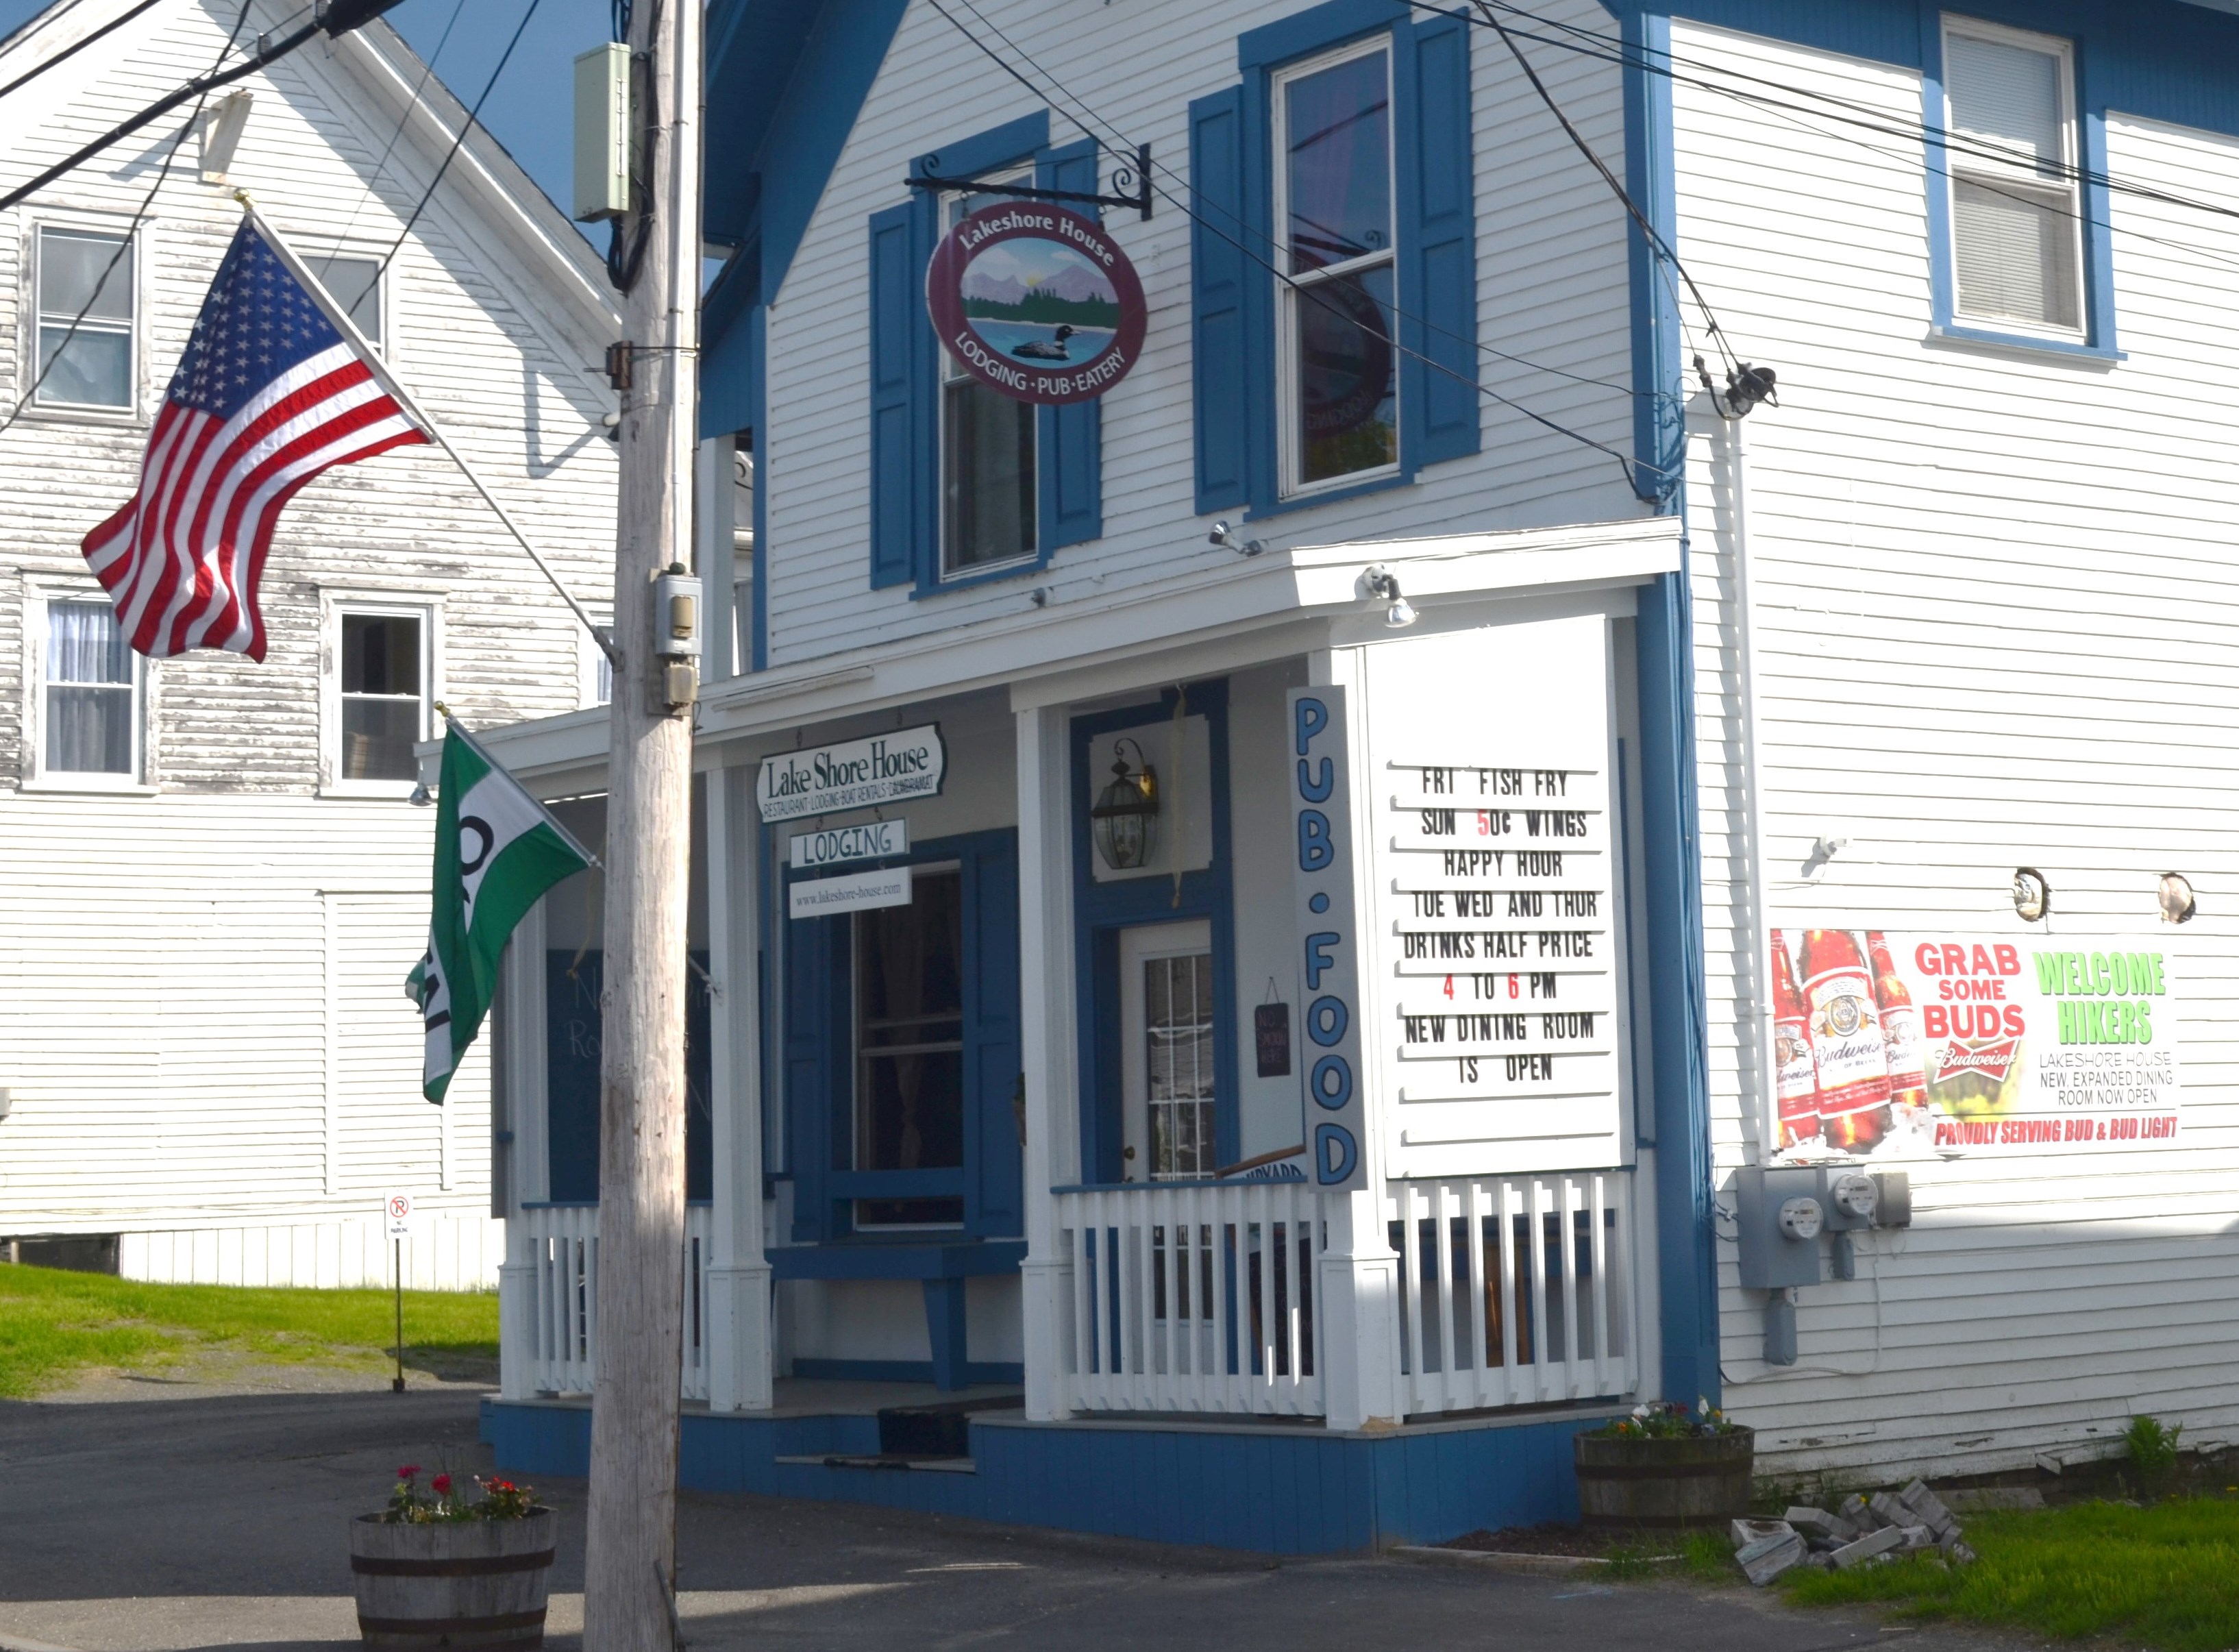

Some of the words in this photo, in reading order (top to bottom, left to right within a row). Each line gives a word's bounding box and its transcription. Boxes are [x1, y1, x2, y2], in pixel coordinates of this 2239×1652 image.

[958, 211, 1054, 251] Lakeshore
[1059, 217, 1114, 266] House
[955, 332, 1028, 391] LODGING
[1037, 378, 1071, 395] PUB
[1076, 347, 1126, 392] EATERY
[767, 759, 811, 798] Lake
[813, 752, 869, 789] Shore
[871, 740, 928, 780] House
[1422, 767, 1454, 794] FRI
[1479, 768, 1523, 796] FISH
[1535, 769, 1568, 797] FRY
[1296, 697, 1334, 872] PUB
[1421, 809, 1456, 835] SUN
[1525, 810, 1587, 837] WINGS
[803, 824, 891, 864] LODGING
[1444, 850, 1505, 876] HAPPY
[1517, 850, 1563, 877] HOUR
[796, 884, 901, 907] www.lakeshore-house.com
[1411, 891, 1445, 917] TUE
[1455, 891, 1494, 917] WED
[1508, 891, 1543, 917] AND
[1551, 891, 1597, 917] THUR
[1405, 932, 1475, 959] DRINKS
[1483, 931, 1529, 959] HALF
[1539, 930, 1594, 958] PRICE
[1915, 942, 2021, 976] GRAB
[1443, 973, 1455, 1000] 4
[1471, 972, 1495, 1000] TO
[1507, 972, 1520, 999] 6
[1530, 972, 1557, 999] PM
[2031, 952, 2166, 996] WELCOME
[1938, 979, 2007, 1000] SOME
[1405, 1015, 1446, 1044] NEW
[1457, 1013, 1527, 1041] DINING
[1542, 1012, 1594, 1039] ROOM
[1923, 1004, 2025, 1039] BUDS
[2057, 1000, 2153, 1045] HIKERS
[1305, 932, 1358, 1187] FOOD
[1459, 1056, 1479, 1083] IS
[1506, 1054, 1553, 1082] OPEN
[1816, 1040, 1883, 1069] Budweise
[1935, 1047, 2016, 1070] Budweiser
[2040, 1052, 2123, 1068] LAKESHORE
[2127, 1052, 2173, 1067] HOUSE
[2073, 1071, 2133, 1087] EXPANDED
[2136, 1070, 2173, 1086] DINING
[2058, 1089, 2094, 1106] ROOM
[2097, 1089, 2125, 1105] NOW
[2127, 1088, 2157, 1104] OPEN
[1934, 1122, 1999, 1146] PROUDLY
[2001, 1120, 2062, 1144] SERVING
[2064, 1119, 2094, 1142] BUD
[2096, 1122, 2107, 1141] &
[2110, 1118, 2139, 1140] BUD
[2140, 1117, 2178, 1139] LIGHT
